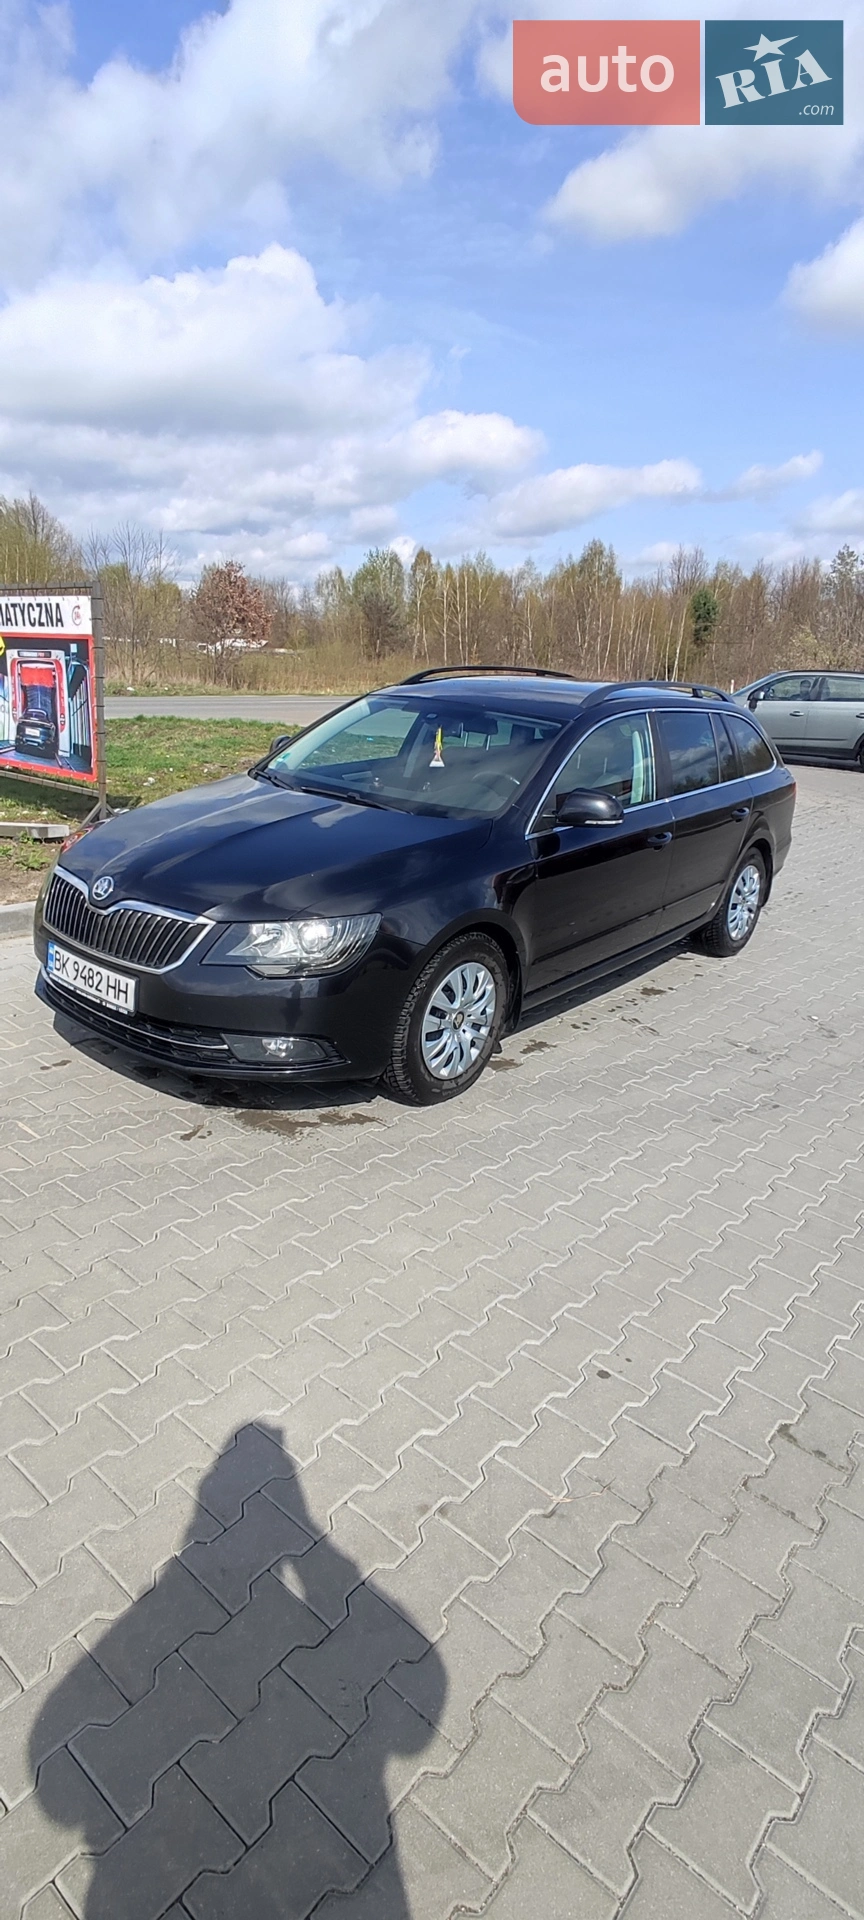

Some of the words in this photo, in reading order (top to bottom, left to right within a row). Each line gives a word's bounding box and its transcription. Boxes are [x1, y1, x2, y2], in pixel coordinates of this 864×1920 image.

[54, 950, 70, 978] BK
[73, 960, 103, 993] 9482
[106, 975, 129, 1004] HH
